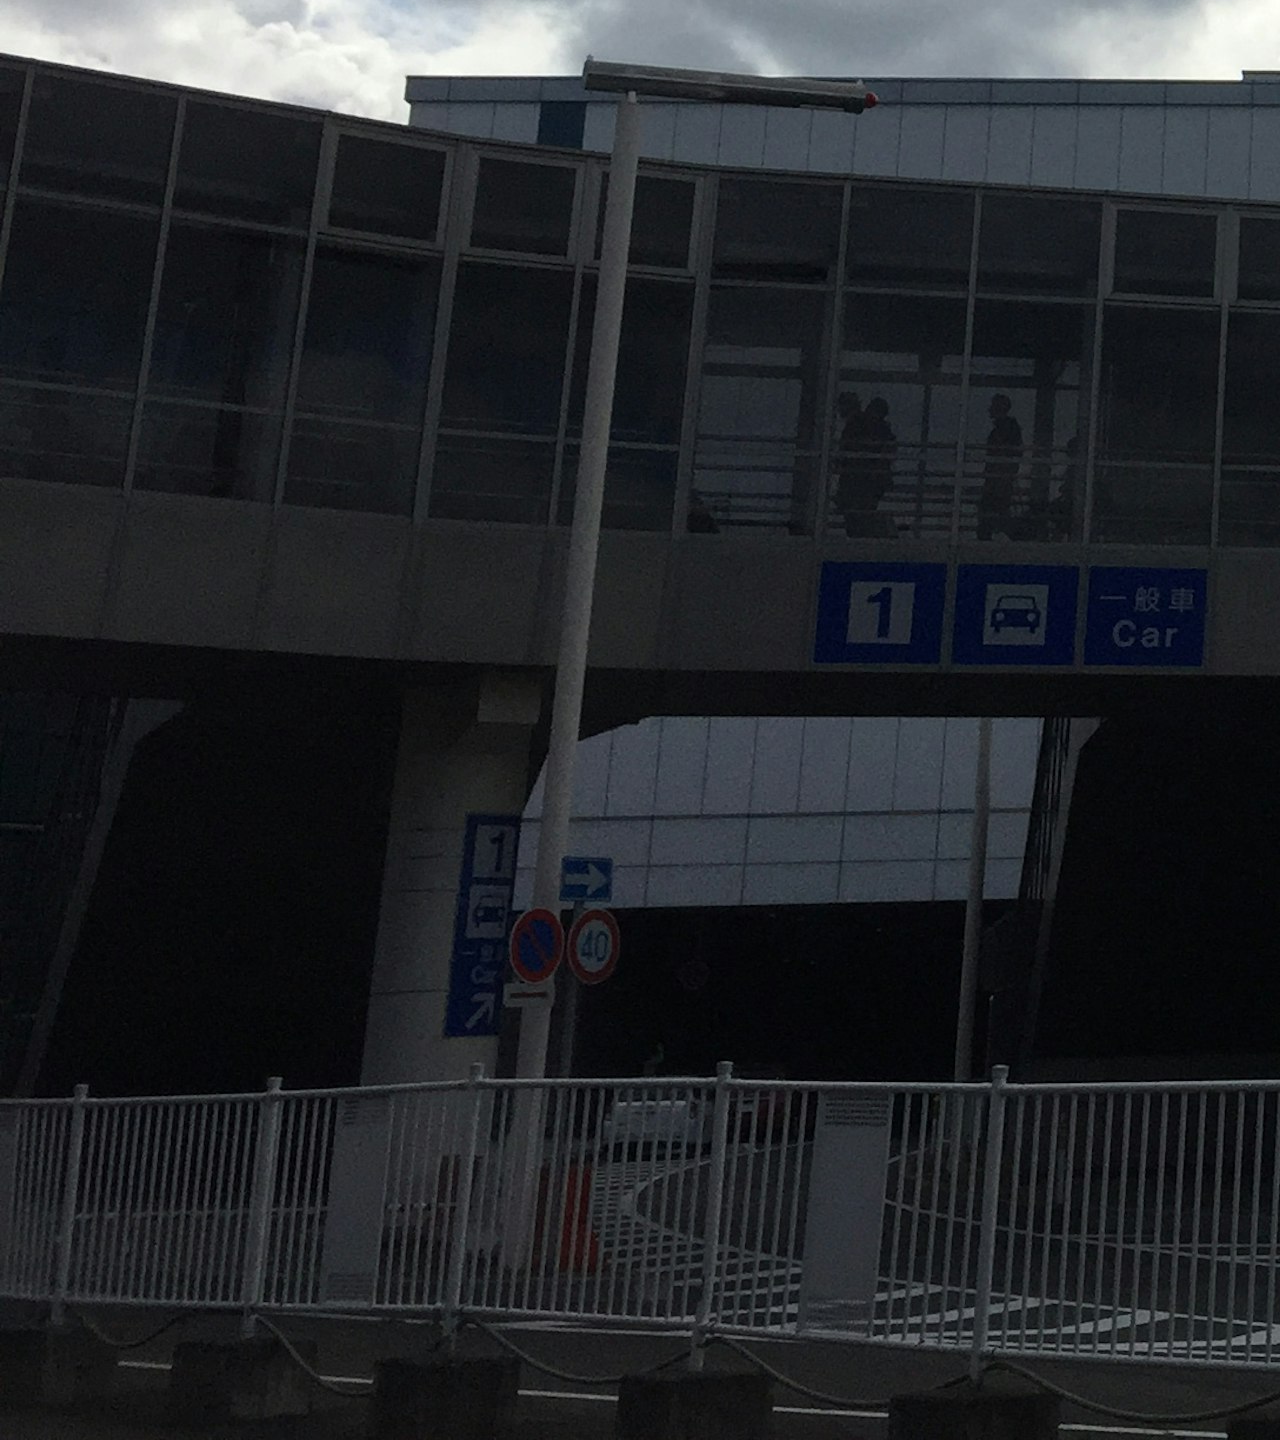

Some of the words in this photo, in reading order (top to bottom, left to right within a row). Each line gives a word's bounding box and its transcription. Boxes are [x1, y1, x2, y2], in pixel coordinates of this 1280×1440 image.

[867, 587, 893, 638] 1
[1099, 586, 1196, 613] 一般車
[1111, 618, 1179, 648] Car
[489, 831, 506, 873] 1
[580, 930, 609, 963] 40
